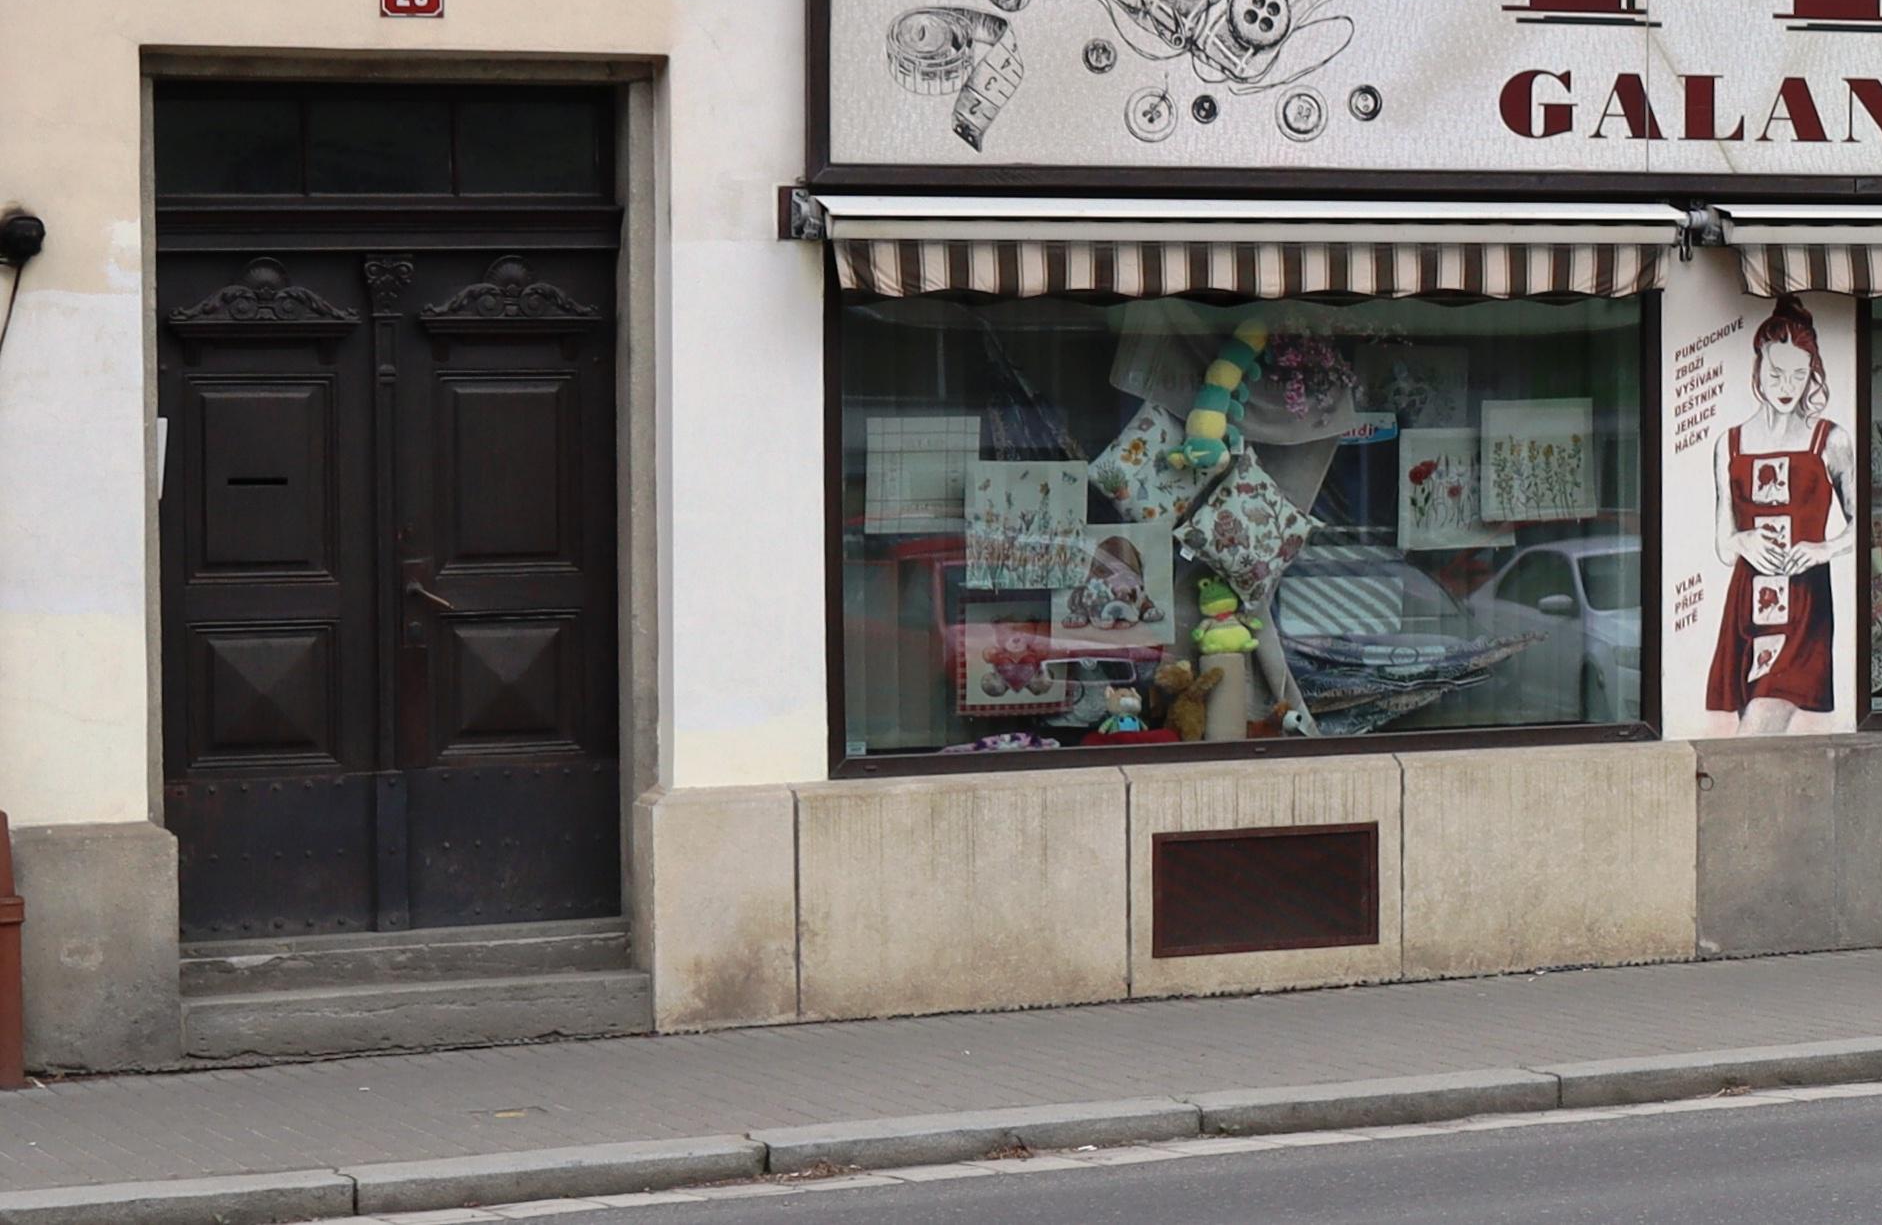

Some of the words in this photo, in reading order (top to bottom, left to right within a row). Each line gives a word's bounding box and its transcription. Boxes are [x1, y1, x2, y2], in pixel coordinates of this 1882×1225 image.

[1675, 316, 1744, 362] PUNČOCHOVÉ
[1675, 354, 1705, 381] ZBOŽÍ
[1675, 383, 1724, 417] DEŠTNÍKY
[1675, 405, 1716, 435] JEHLICE
[1675, 426, 1710, 454] HÁČKY
[1675, 572, 1702, 595] VLNA
[1675, 608, 1698, 632] NITĚ
